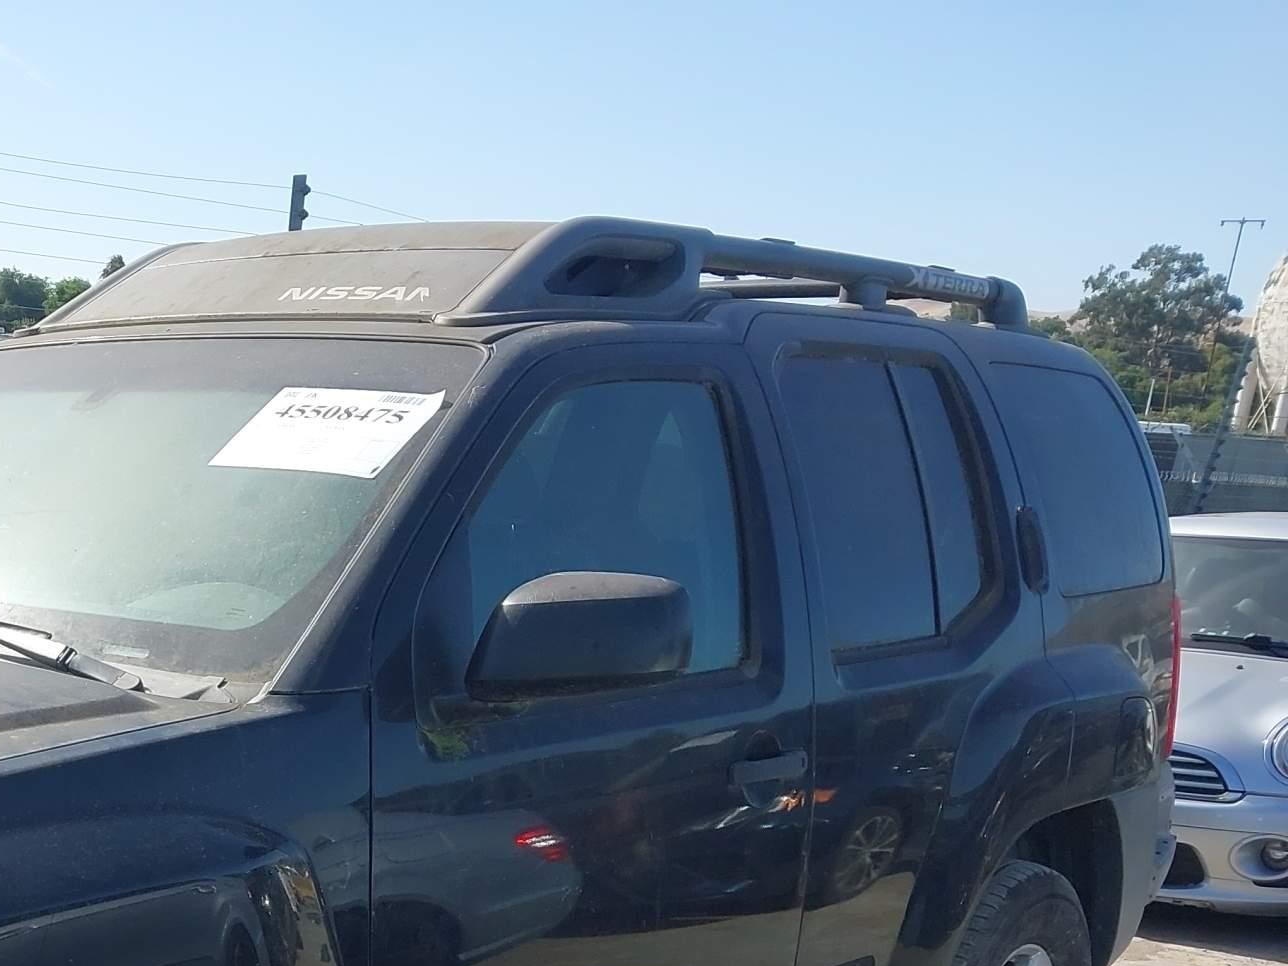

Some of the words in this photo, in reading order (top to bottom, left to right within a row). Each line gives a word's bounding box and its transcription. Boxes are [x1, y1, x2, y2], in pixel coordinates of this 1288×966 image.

[905, 265, 990, 300] XTERRA
[277, 285, 431, 303] NISSAN
[275, 403, 410, 425] 45508475
